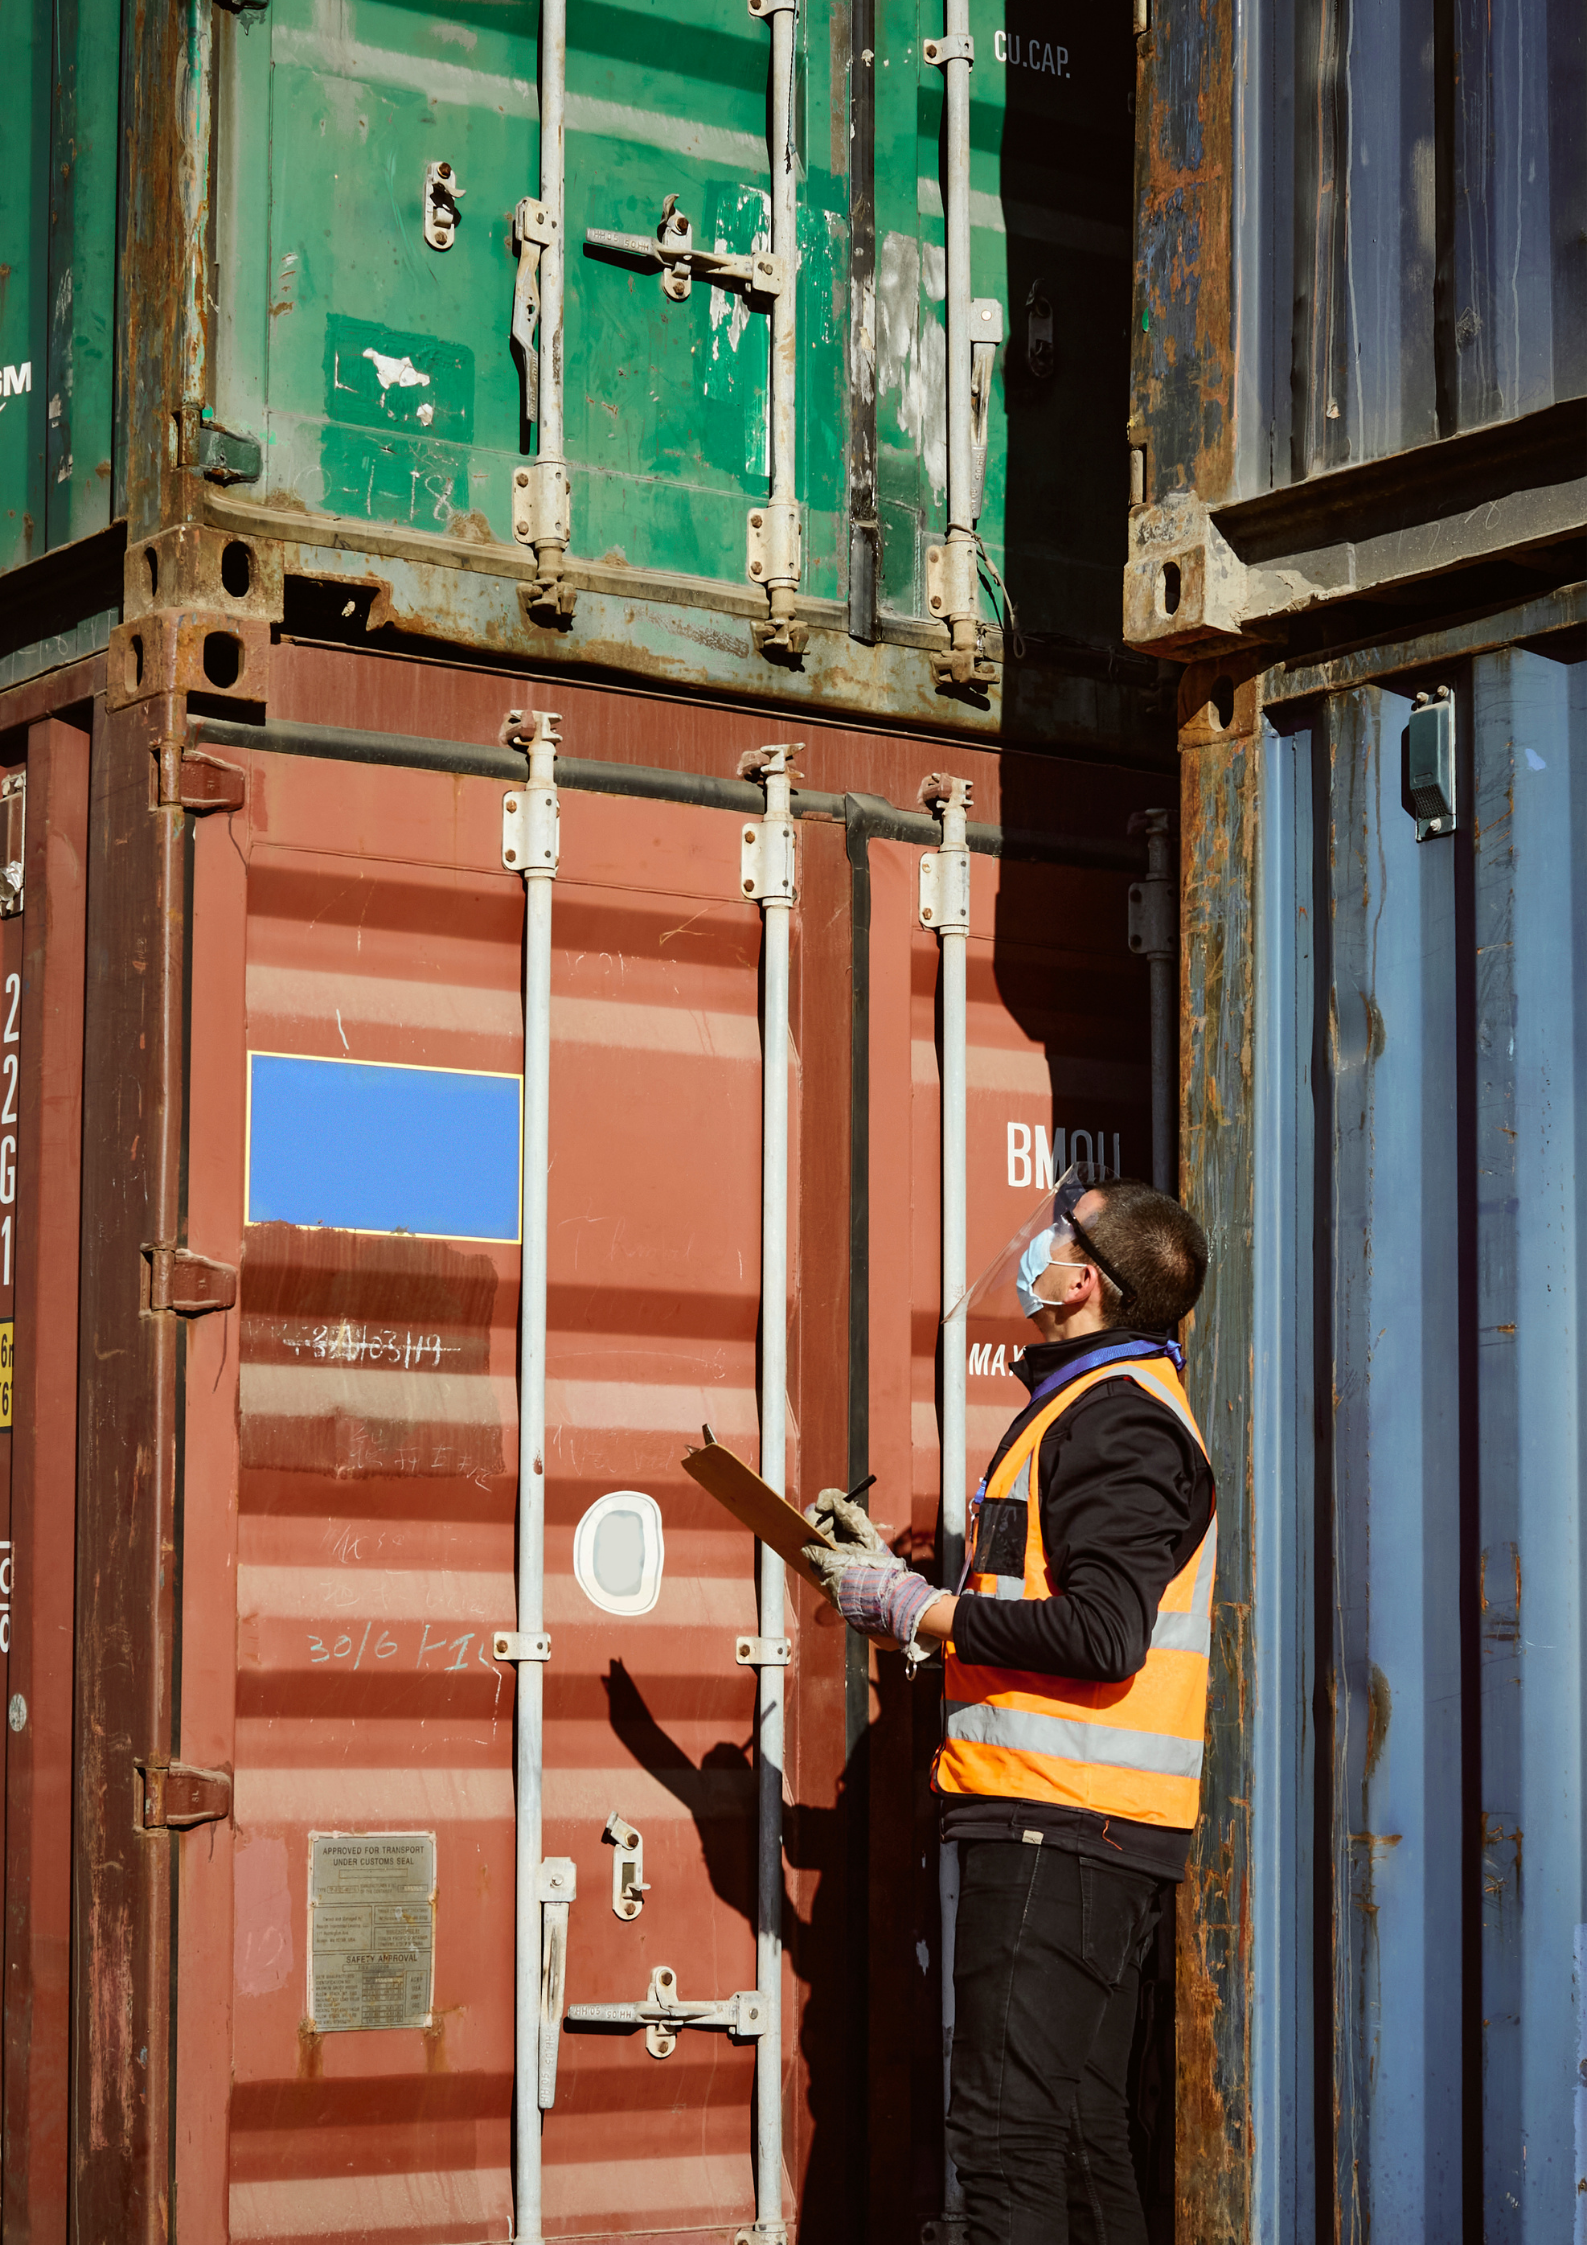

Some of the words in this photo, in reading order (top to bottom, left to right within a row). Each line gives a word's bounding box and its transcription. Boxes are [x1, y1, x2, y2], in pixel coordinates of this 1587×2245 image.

[994, 30, 1071, 79] CU.CAP.
[1007, 1121, 1121, 1190] BMOU
[323, 1846, 362, 1855] APPROVED
[364, 1846, 379, 1854] FOR
[382, 1845, 425, 1854] TRANSPORT
[333, 1858, 358, 1866] UNDER
[360, 1857, 394, 1866] CUSTOMS
[396, 1857, 414, 1865] SEAL
[346, 1955, 375, 1963] SAFETY
[379, 1953, 418, 1963] APPROVAL
